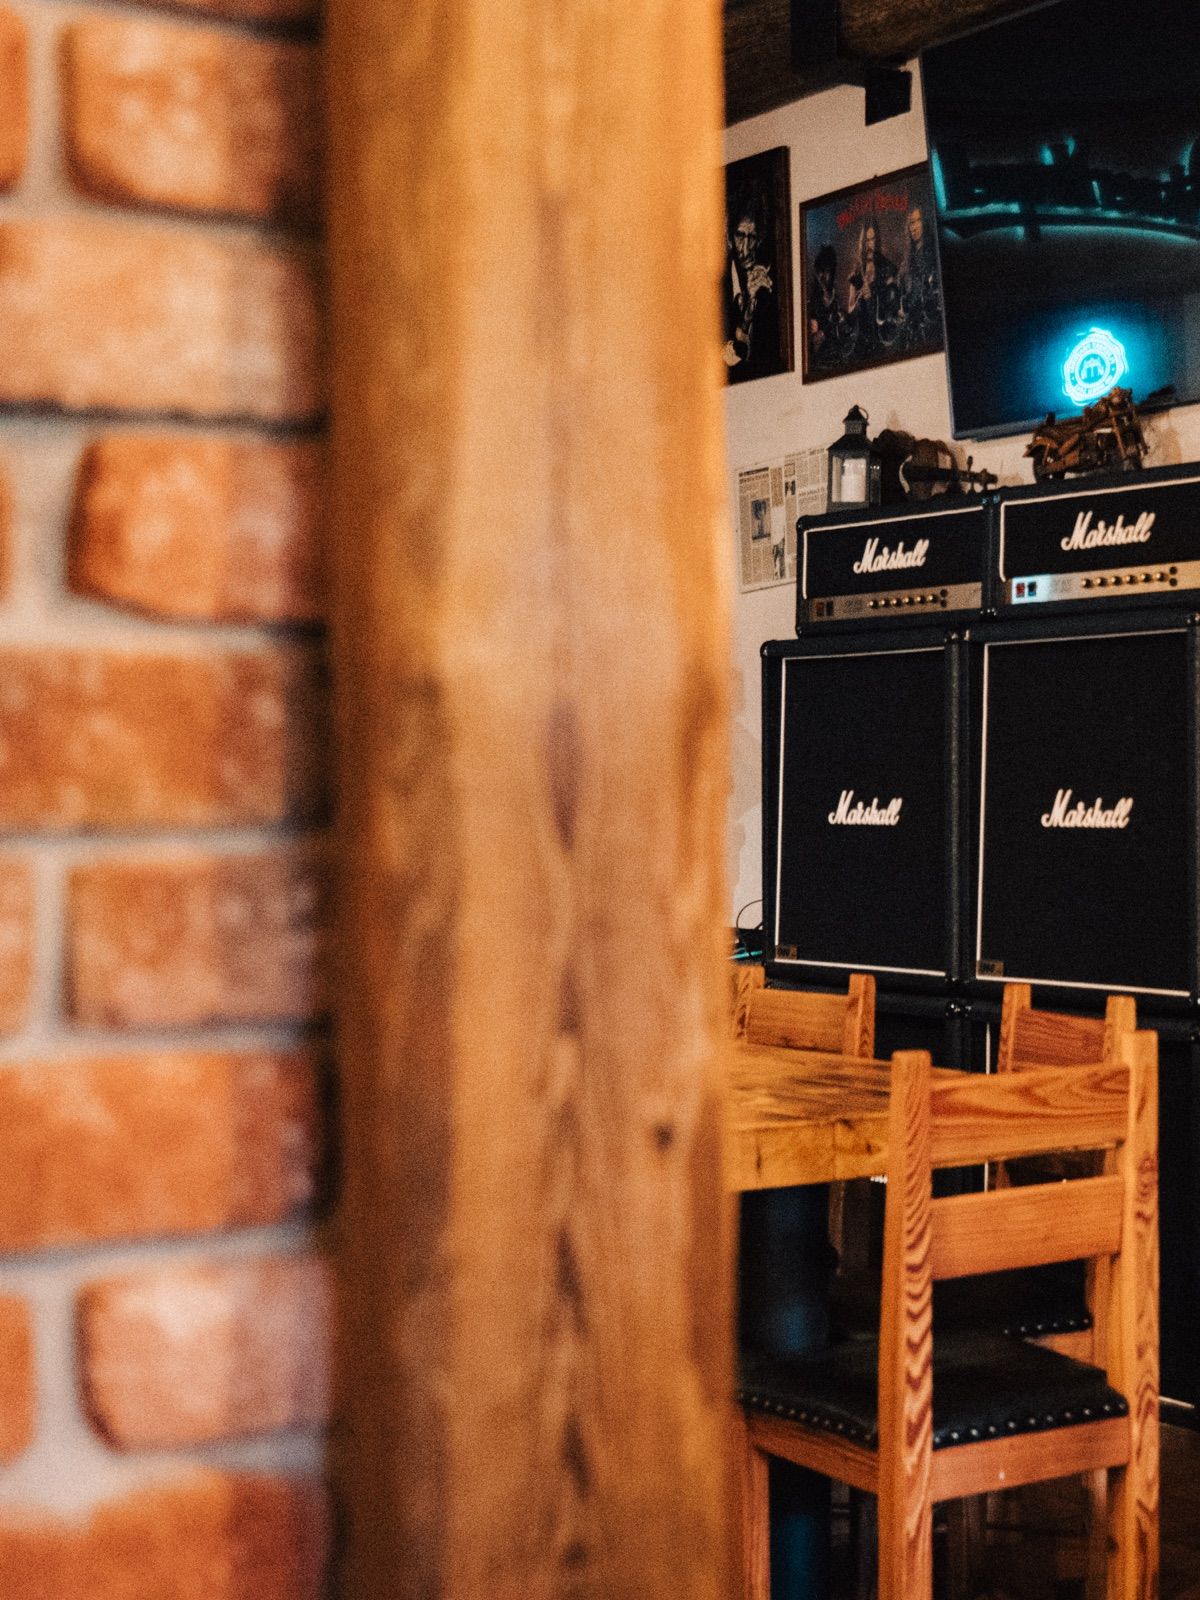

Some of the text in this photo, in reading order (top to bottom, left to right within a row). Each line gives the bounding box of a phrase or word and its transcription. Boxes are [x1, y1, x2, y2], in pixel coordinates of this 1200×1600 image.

[1061, 510, 1155, 551] Marshall
[853, 537, 929, 574] Marshall
[828, 790, 902, 826] Marshall
[1041, 788, 1133, 829] Marshall
